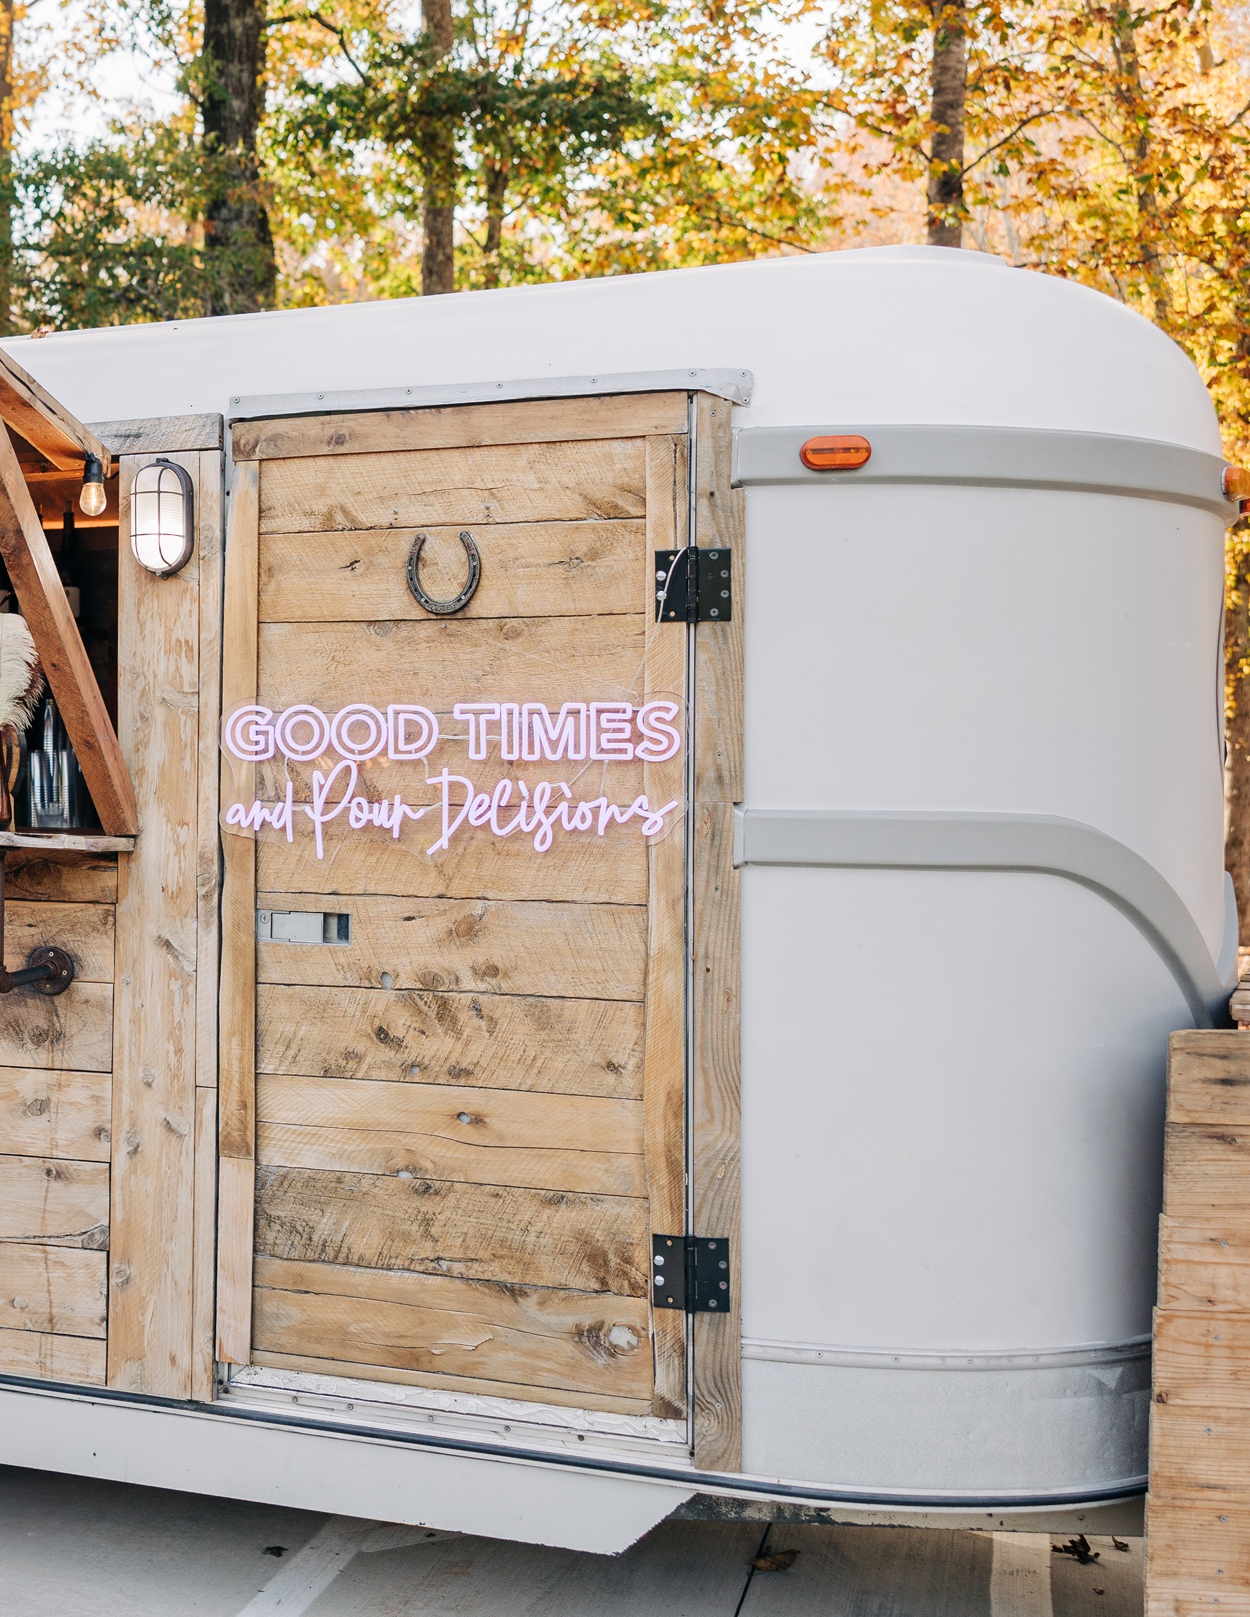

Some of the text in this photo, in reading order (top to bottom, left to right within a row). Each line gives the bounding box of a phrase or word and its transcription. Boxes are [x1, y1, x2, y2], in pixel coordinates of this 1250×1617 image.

[225, 701, 681, 762] GOOD TIMES
[225, 759, 678, 860] and Pour Decisions
